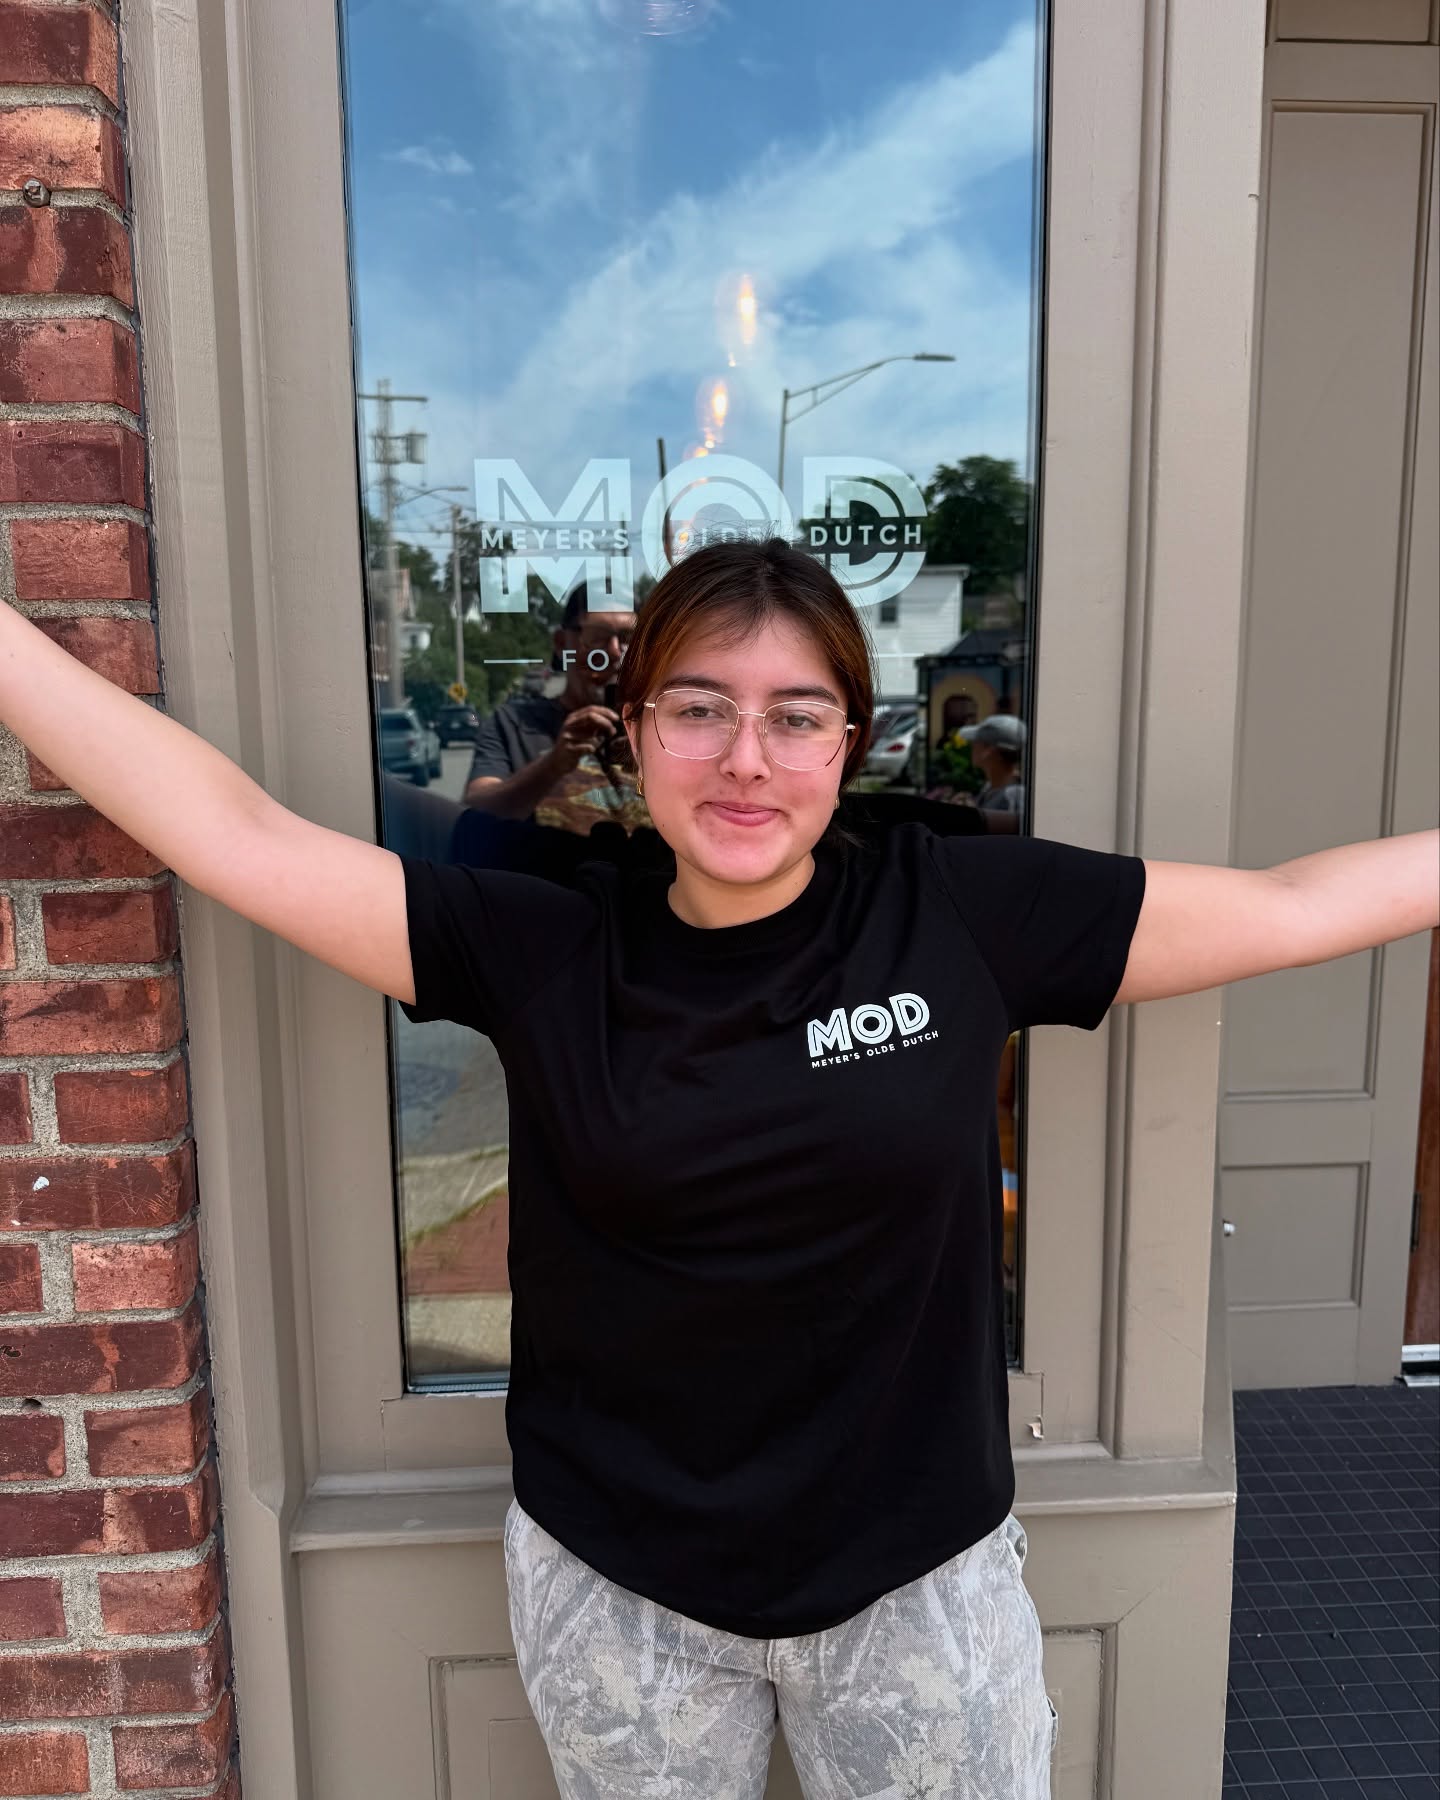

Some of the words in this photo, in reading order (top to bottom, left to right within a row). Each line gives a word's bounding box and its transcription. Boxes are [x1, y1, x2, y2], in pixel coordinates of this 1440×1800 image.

[474, 453, 928, 614] MOD
[480, 527, 630, 551] MEYER'S
[809, 523, 922, 547] DUTCH
[806, 992, 931, 1058] MOD
[811, 1051, 861, 1069] MEYER'S
[866, 1043, 896, 1057] OLDE
[902, 1029, 940, 1048] DUTCH
